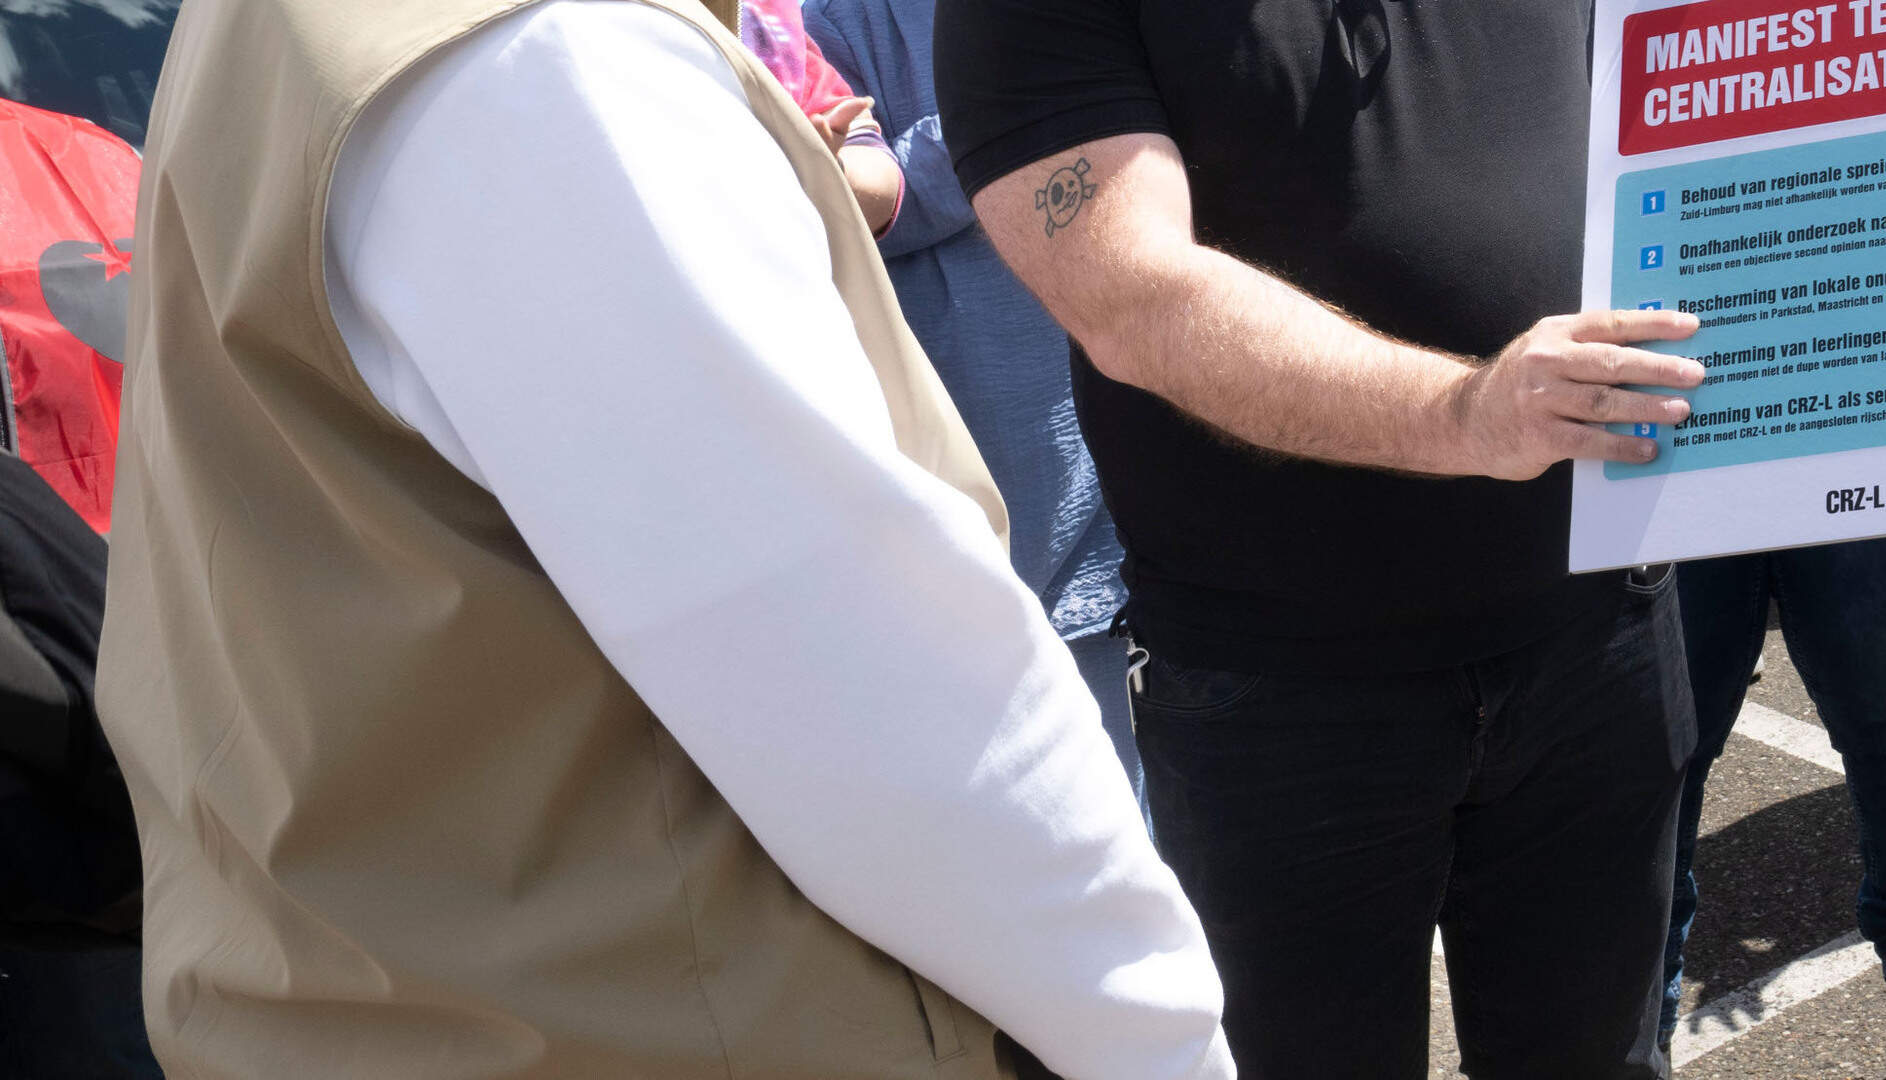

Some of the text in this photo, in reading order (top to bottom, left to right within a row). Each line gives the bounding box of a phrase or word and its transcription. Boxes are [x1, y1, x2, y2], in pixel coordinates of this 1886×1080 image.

[1645, 4, 1837, 74] MANIFEST
[1679, 203, 1741, 221] Zuid-Limburg
[1741, 199, 1763, 211] mag
[1764, 195, 1784, 208] niet
[1784, 186, 1838, 205] afhankelijk
[1838, 182, 1875, 196] worden
[1680, 181, 1737, 205] Behoud
[1739, 178, 1767, 196] van
[1769, 165, 1842, 191] regionale
[1650, 196, 1657, 210] 1
[1678, 229, 1783, 260] Onafhankelijk
[1786, 216, 1867, 244] onderzoek
[1647, 250, 1657, 265] 2
[1678, 263, 1695, 276] Wij
[1695, 261, 1722, 274] eisen
[1723, 258, 1742, 270] een
[1742, 250, 1793, 267] objectieve
[1793, 243, 1829, 259] second
[1829, 239, 1866, 254] opinion
[1677, 287, 1777, 314] Bescherming
[1780, 283, 1808, 301] van
[1811, 273, 1861, 296] lokale
[1698, 311, 1758, 329] hoolhouders
[1758, 309, 1769, 321] in
[1770, 302, 1816, 319] Parkstad,
[1816, 294, 1870, 313] Maastricht
[1870, 293, 1884, 305] en
[1680, 344, 1776, 369] scherming
[1779, 340, 1808, 358] van
[1726, 368, 1759, 382] mogen
[1760, 364, 1780, 378] niet
[1781, 362, 1794, 375] de
[1795, 360, 1820, 373] dupe
[1821, 355, 1859, 369] worden
[1859, 352, 1878, 364] van
[1754, 401, 1783, 420] van
[1786, 392, 1833, 415] CRZ-L
[1837, 390, 1862, 409] als
[1672, 435, 1689, 448] Het
[1690, 431, 1711, 446] CBR
[1712, 428, 1738, 443] moet
[1738, 424, 1768, 439] CRZ-L
[1769, 424, 1783, 435] en
[1783, 421, 1797, 433] de
[1798, 414, 1858, 432] aangesloten
[1826, 485, 1885, 514] CRZ-L
